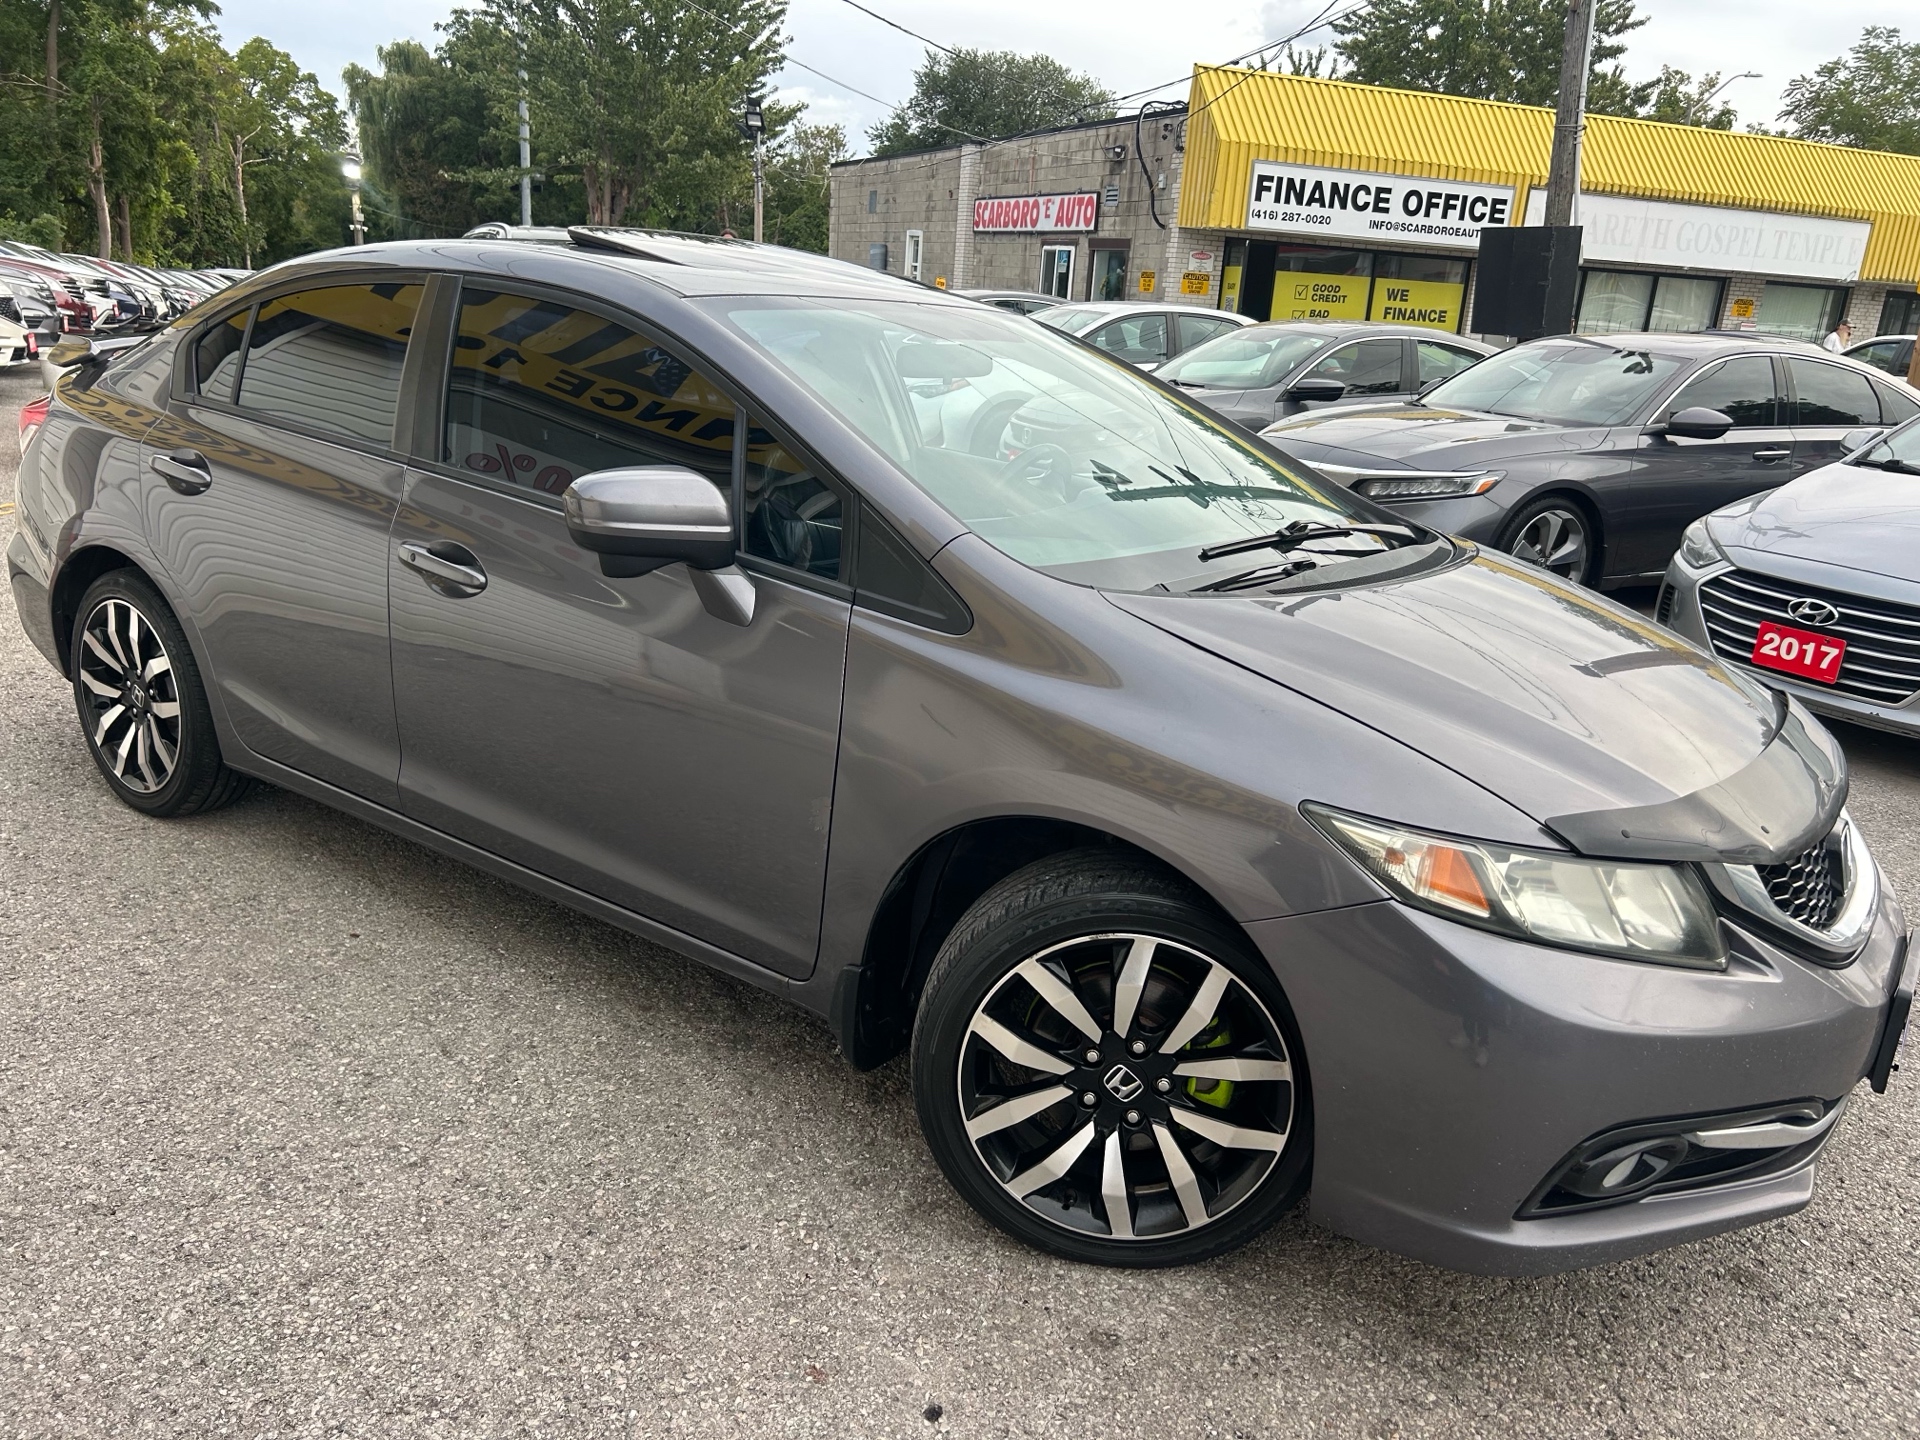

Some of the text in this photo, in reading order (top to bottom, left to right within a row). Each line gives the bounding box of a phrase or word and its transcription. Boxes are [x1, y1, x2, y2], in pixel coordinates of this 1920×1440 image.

[1254, 173, 1509, 225] FINANCE OFFICE
[973, 198, 1041, 230] SCARBORO
[1054, 195, 1095, 229] AUTO
[1251, 208, 1332, 226] (416) 287-0020
[1676, 221, 1767, 259] GOSPEL
[1772, 229, 1864, 267] TEMPLE
[1184, 273, 1209, 281] CAUTION
[1312, 283, 1341, 293] GOOD
[1386, 287, 1410, 302] WE
[1311, 293, 1347, 304] CREDIT
[1309, 309, 1330, 318] BAD
[1383, 306, 1448, 323] FINANCE
[1759, 632, 1840, 669] 2017
